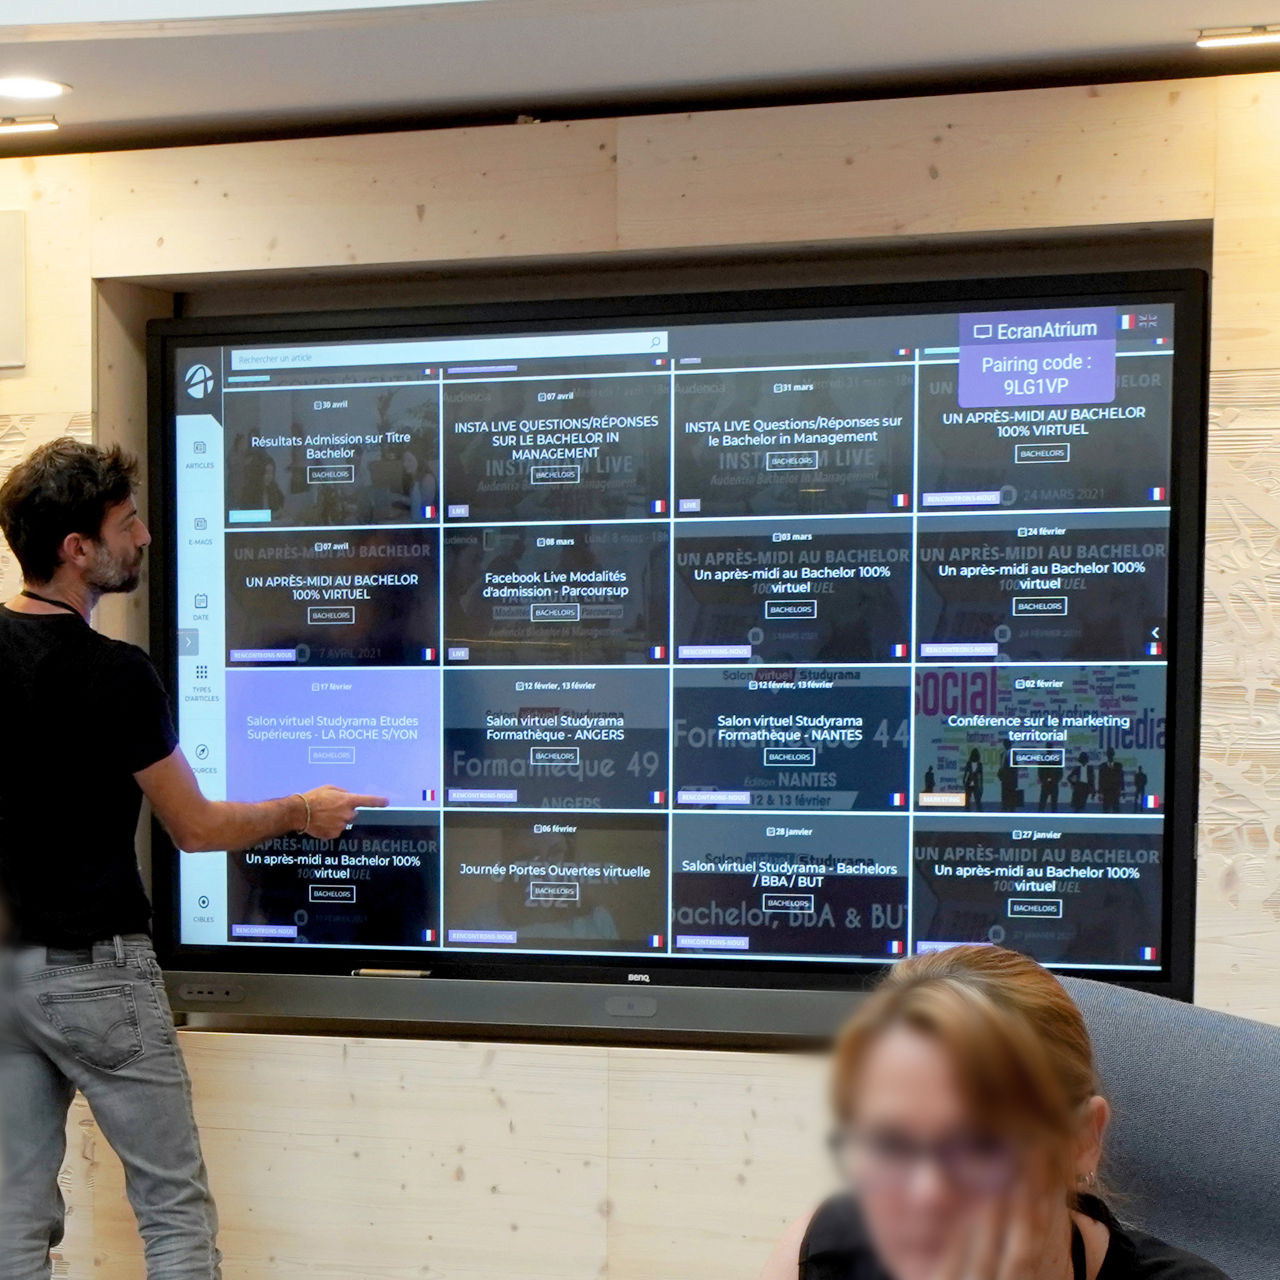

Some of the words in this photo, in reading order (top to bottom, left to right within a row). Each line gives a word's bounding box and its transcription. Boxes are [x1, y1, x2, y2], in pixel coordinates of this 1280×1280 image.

[998, 321, 1097, 340] EcranAtrium
[239, 355, 277, 364] Rechercher
[291, 353, 312, 362] article
[982, 357, 1037, 375] Pairing
[1043, 354, 1083, 370] code
[1004, 378, 1069, 395] 9LG1VP
[557, 392, 573, 400] avril
[323, 401, 330, 409] 30
[943, 413, 963, 424] UN
[966, 409, 1045, 423] APRÈS-MIDI
[1048, 410, 1067, 421] AU
[1071, 407, 1145, 420] BACHELOR
[455, 422, 489, 433] INSTA
[492, 421, 516, 432] LIVE
[520, 415, 659, 431] QUESTIONS/RÉPONSES
[685, 422, 721, 433] INSTA
[724, 421, 750, 431] LIVE
[754, 416, 880, 432] Questions/Réponses
[883, 417, 902, 427] sur
[997, 425, 1030, 437] 100%
[1033, 424, 1089, 435] VIRTUEL
[251, 436, 302, 448] Résultats
[305, 434, 362, 445] Admission
[365, 435, 382, 443] sur
[385, 432, 411, 443] Titre
[492, 436, 516, 446] SUR
[520, 435, 534, 445] LE
[537, 433, 602, 445] BACHELOR
[607, 432, 619, 442] IN
[709, 436, 720, 446] le
[723, 435, 776, 446] Bachelor
[780, 434, 791, 444] in
[794, 431, 878, 446] Management
[306, 448, 355, 459] Bachelor
[512, 447, 599, 461] MANAGEMENT
[1021, 450, 1064, 458] BACHELORS
[1039, 527, 1066, 535] février
[695, 569, 712, 580] Un
[715, 567, 780, 582] après-midi
[783, 569, 798, 578] au
[801, 567, 856, 578] Bachelor
[859, 566, 890, 577] 100%
[939, 565, 957, 577] Un
[960, 563, 1028, 578] après-midi
[1031, 565, 1048, 575] au
[1052, 563, 1108, 574] Bachelor
[1113, 562, 1145, 573] 100%
[246, 576, 264, 587] UN
[266, 573, 332, 586] APRÈS-MIDI
[336, 575, 352, 585] AU
[355, 575, 418, 585] BACHELOR
[485, 572, 541, 584] Facebook
[544, 572, 567, 583] Live
[570, 571, 626, 582] Modalités
[1020, 578, 1061, 589] virtuel
[483, 586, 551, 598] d'admission
[562, 586, 628, 597] Parcoursup
[771, 582, 811, 592] virtuel
[293, 589, 320, 600] 100%
[323, 589, 370, 599] VIRTUEL
[525, 682, 533, 690] 12
[534, 681, 560, 691] février,
[571, 681, 596, 690] février
[759, 681, 767, 689] 12
[768, 681, 796, 690] février,
[808, 681, 833, 689] février
[1037, 680, 1064, 688] février
[247, 716, 277, 727] Salon
[279, 716, 314, 726] virtuel
[317, 716, 377, 728] Studyrama
[380, 716, 418, 726] Etudes
[486, 716, 518, 726] Salon
[520, 716, 558, 726] virtuel
[560, 716, 624, 728] Studyrama
[718, 716, 751, 727] Salon
[754, 715, 793, 727] virtuel
[795, 715, 863, 729] Studyrama
[948, 715, 1021, 727] Conférence
[1024, 718, 1044, 727] sur
[1048, 715, 1059, 726] le
[1063, 715, 1130, 729] marketing
[247, 729, 312, 741] Supérieures
[322, 730, 336, 739] LA
[339, 729, 379, 739] ROCHE
[382, 728, 418, 741] S/YON
[487, 729, 565, 742] Formathèque
[574, 730, 625, 740] ANGERS
[719, 729, 801, 742] Formathèque
[811, 730, 863, 741] NANTES
[1009, 729, 1067, 741] territorial
[769, 753, 811, 761] BACHELORS
[778, 772, 837, 787] NANTES
[552, 825, 576, 833] février
[786, 828, 812, 837] janvier
[1023, 831, 1032, 839] 27
[1033, 830, 1061, 840] janvier
[246, 854, 261, 864] Un
[264, 853, 322, 866] après-midi
[325, 856, 338, 865] au
[342, 855, 389, 866] Bachelor
[393, 856, 420, 866] 100%
[315, 868, 350, 878] virtuel
[460, 864, 506, 875] Journée
[509, 865, 546, 876] Portes
[548, 865, 600, 877] Ouvertes
[603, 866, 651, 878] virtuelle
[682, 861, 715, 872] Salon
[718, 861, 756, 872] virtuel
[759, 862, 826, 875] Studyrama
[837, 863, 897, 875] Bachelors
[753, 874, 759, 887] /
[761, 876, 788, 887] BBA
[789, 875, 795, 888] /
[798, 876, 824, 888] BUT
